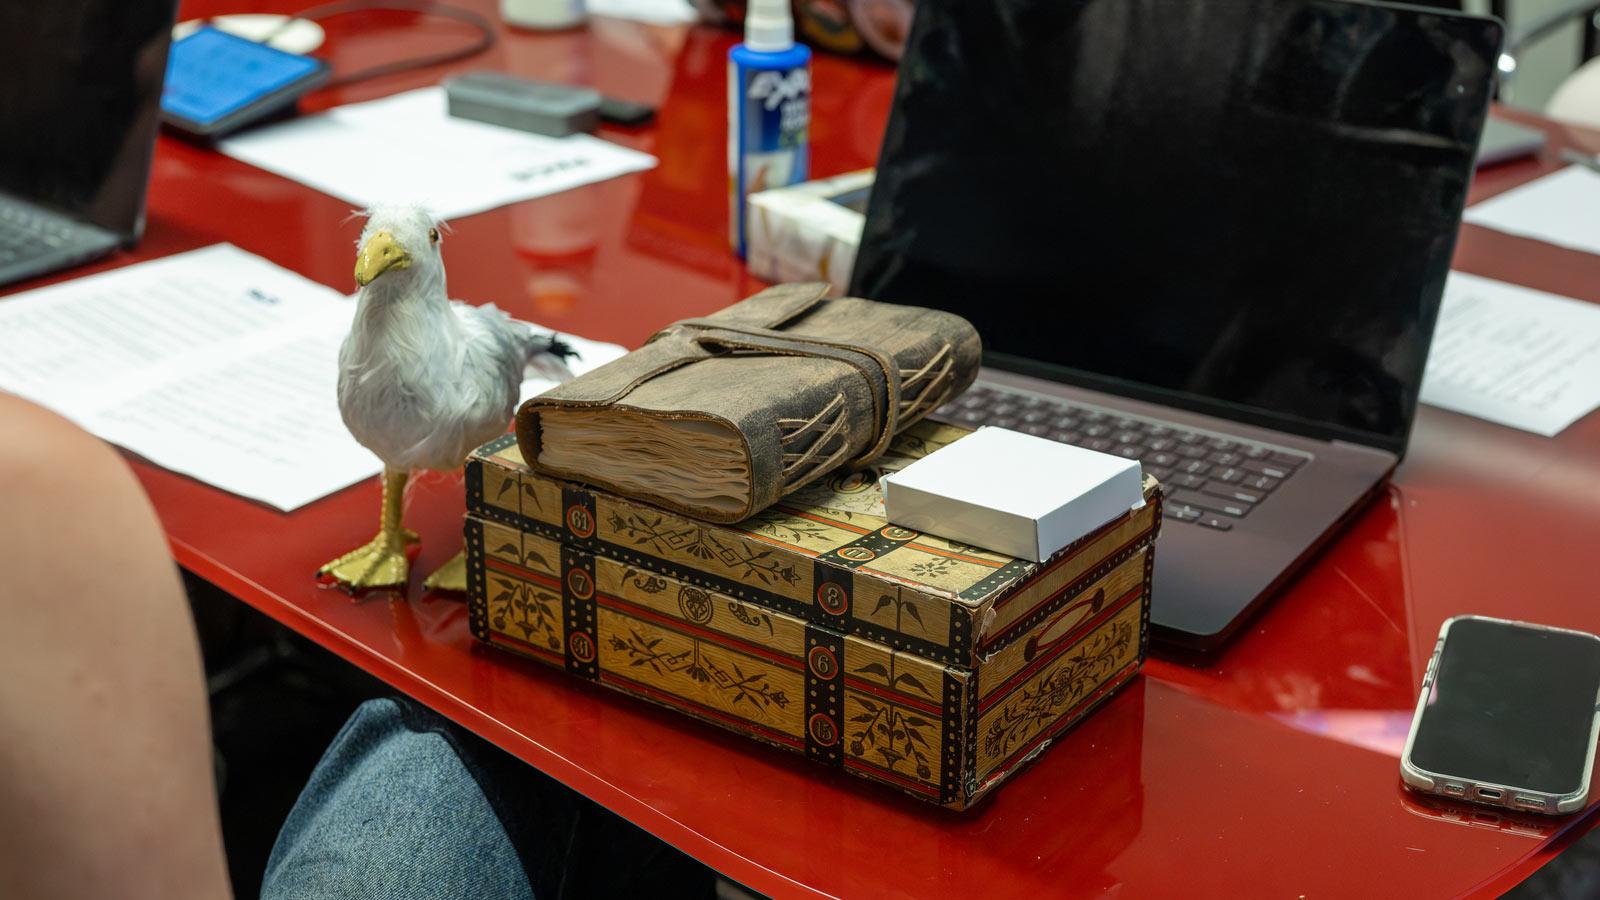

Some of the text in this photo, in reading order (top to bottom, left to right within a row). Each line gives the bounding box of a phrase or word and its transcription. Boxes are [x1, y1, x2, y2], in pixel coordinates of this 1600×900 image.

[571, 509, 588, 531] 61
[575, 574, 585, 593] 7
[827, 587, 839, 607] 8
[818, 655, 829, 673] 6
[816, 720, 832, 740] 15
